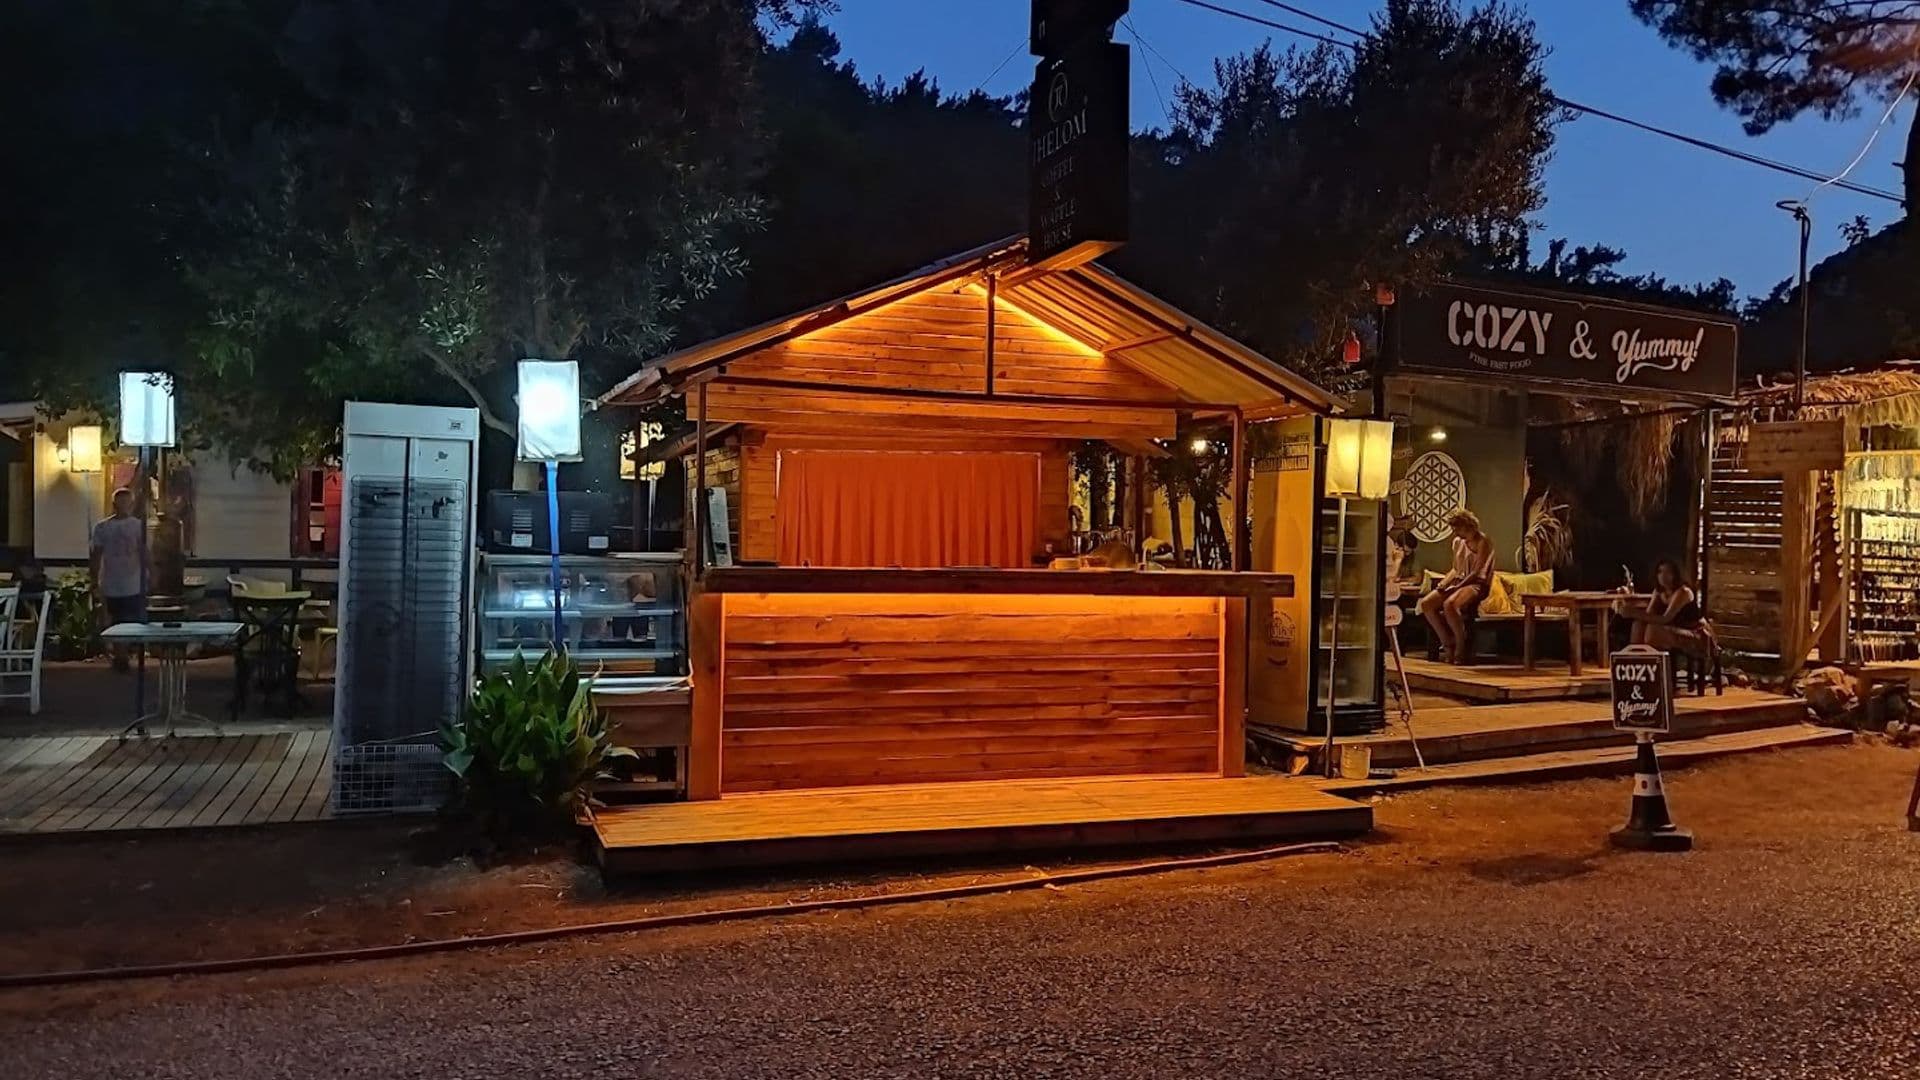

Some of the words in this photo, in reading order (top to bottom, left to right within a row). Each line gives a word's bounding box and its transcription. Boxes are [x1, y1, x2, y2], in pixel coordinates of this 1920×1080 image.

[1448, 300, 1553, 355] COZY
[1569, 320, 1597, 360] &
[1611, 327, 1704, 382] Yummy!
[1615, 664, 1657, 682] COZY
[1631, 685, 1644, 700] &
[1618, 698, 1659, 721] Yummy!
